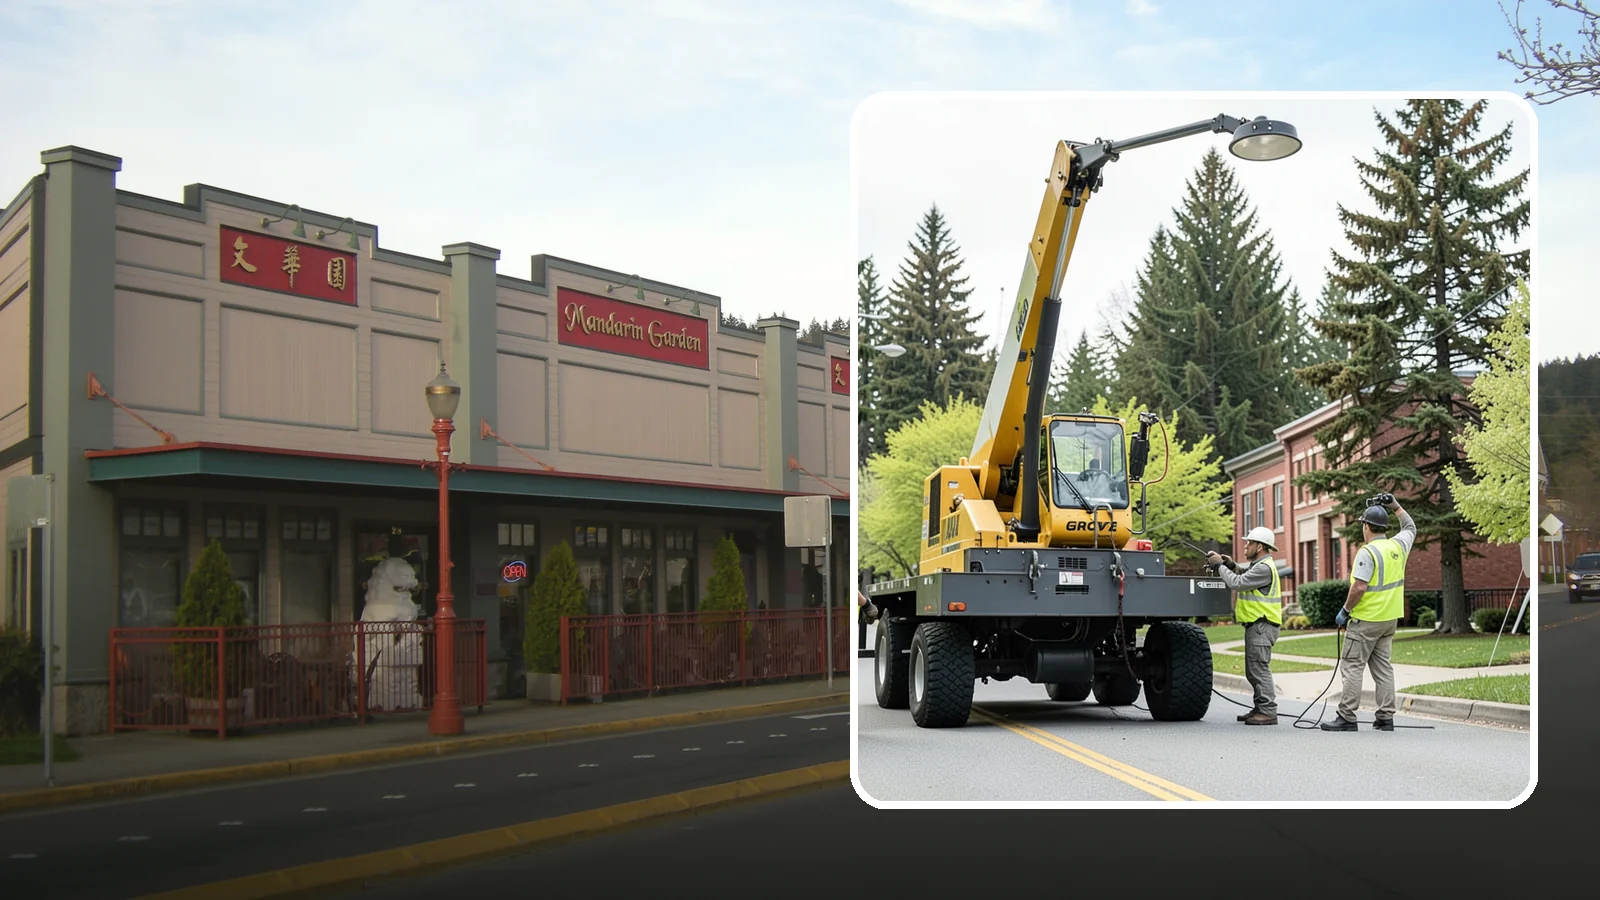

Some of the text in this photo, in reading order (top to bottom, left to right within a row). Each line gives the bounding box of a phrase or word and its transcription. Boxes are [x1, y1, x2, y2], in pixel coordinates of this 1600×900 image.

[230, 235, 347, 291] 文華園
[564, 302, 702, 352] Mandarin Garden
[1066, 520, 1118, 532] GROVE
[503, 565, 527, 578] OPEN
